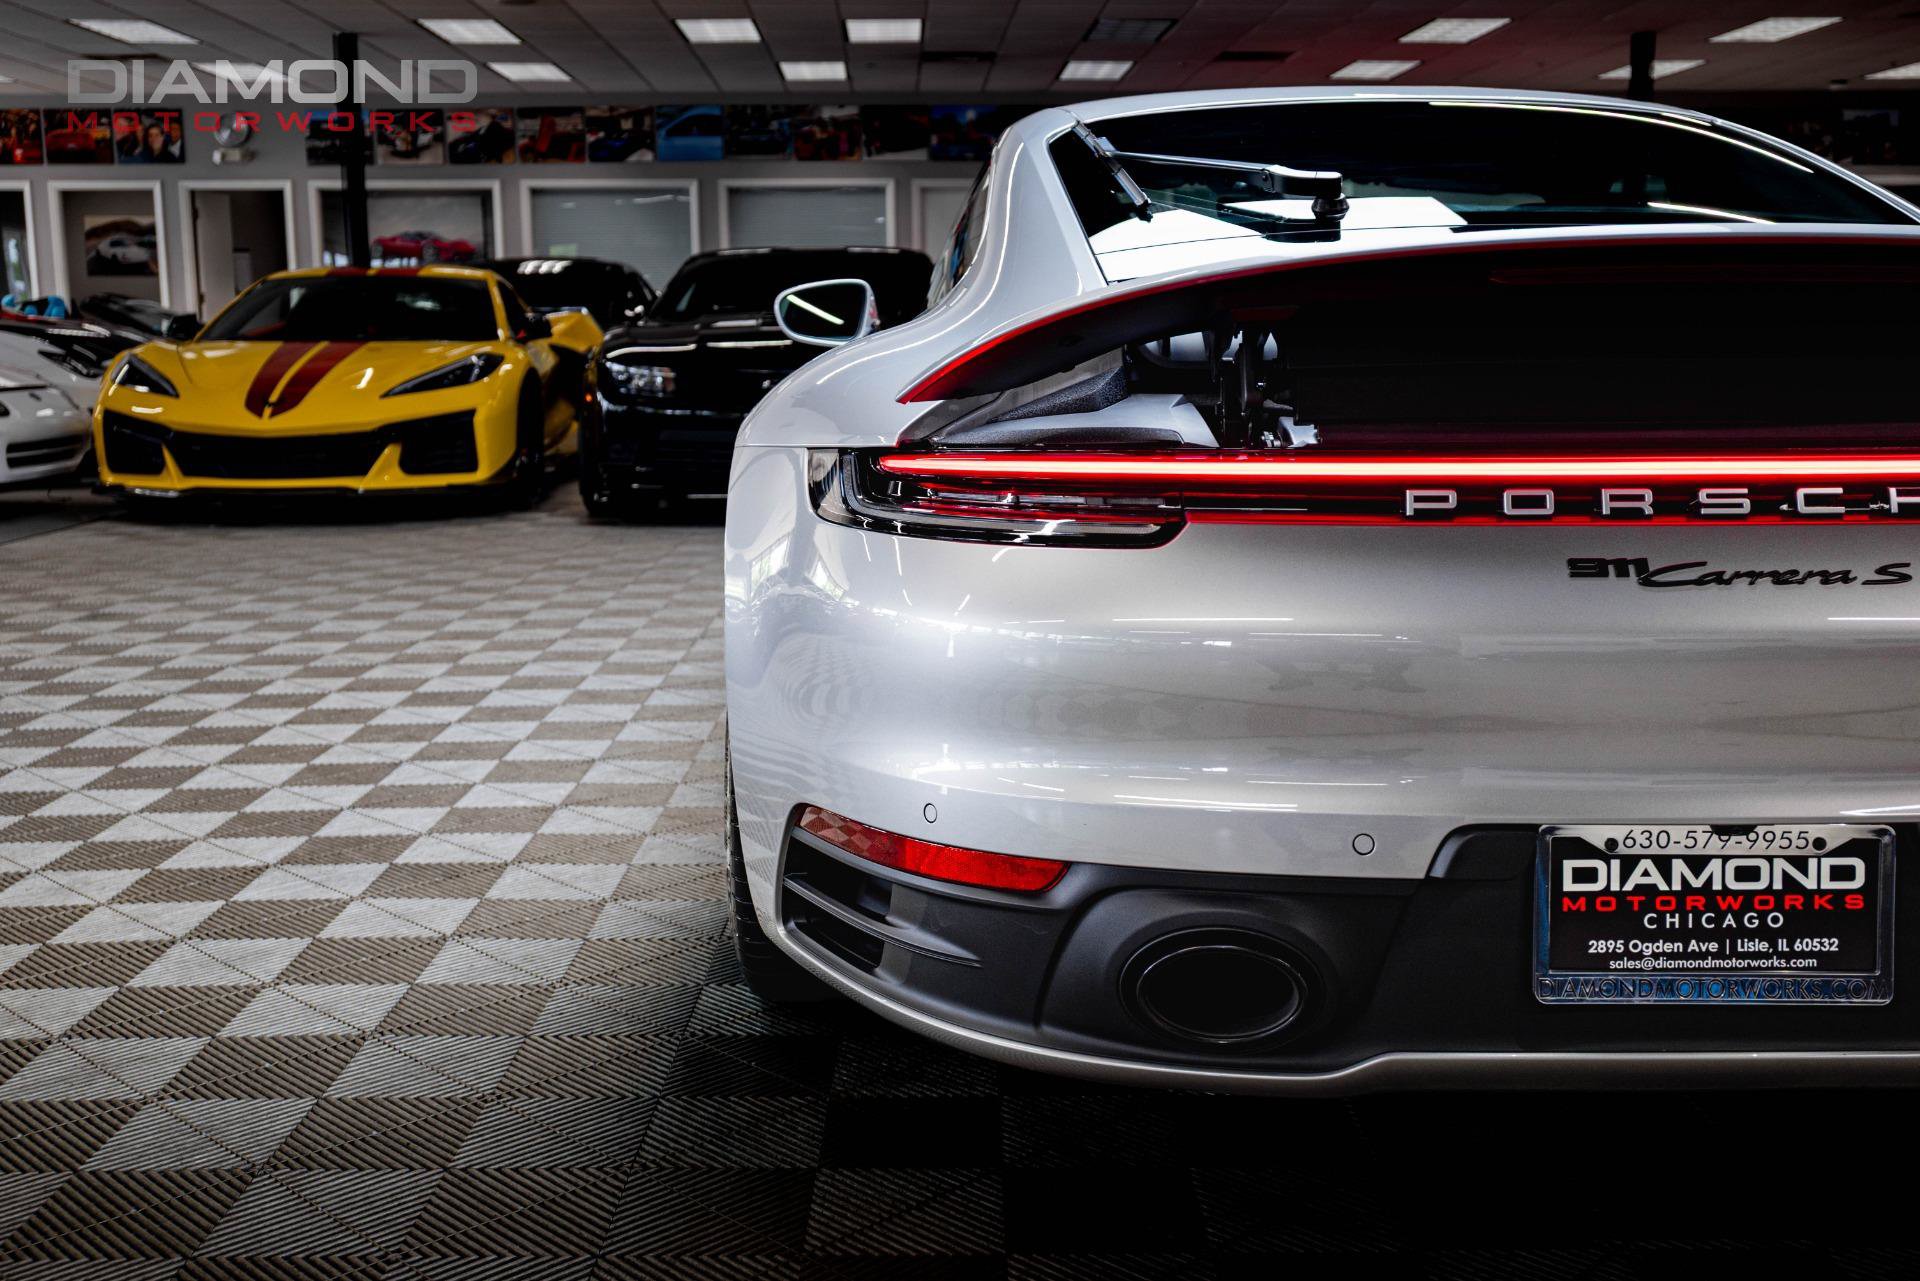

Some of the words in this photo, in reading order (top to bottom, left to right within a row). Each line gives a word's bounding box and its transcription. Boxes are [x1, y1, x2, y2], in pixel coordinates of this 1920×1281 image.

[1567, 557, 1648, 578] 911
[1638, 561, 1858, 588] Carrera
[1861, 562, 1913, 586] S
[1622, 829, 1810, 850] 630-579-9955
[1562, 857, 1866, 892] DIAMOND
[1562, 894, 1865, 912] MOTORWORKS
[1643, 912, 1784, 929] CHICAGO
[1588, 939, 1625, 953] 2895
[1628, 939, 1683, 955] Ogden
[1687, 939, 1719, 953] Ave
[1737, 938, 1773, 953] Lisle,
[1777, 938, 1790, 952] IL
[1793, 938, 1839, 952] 60532
[1609, 956, 1818, 970] sales@diamondmotorworks.com
[1538, 977, 1891, 999] DIAMONDMOTORWORKS.COM
